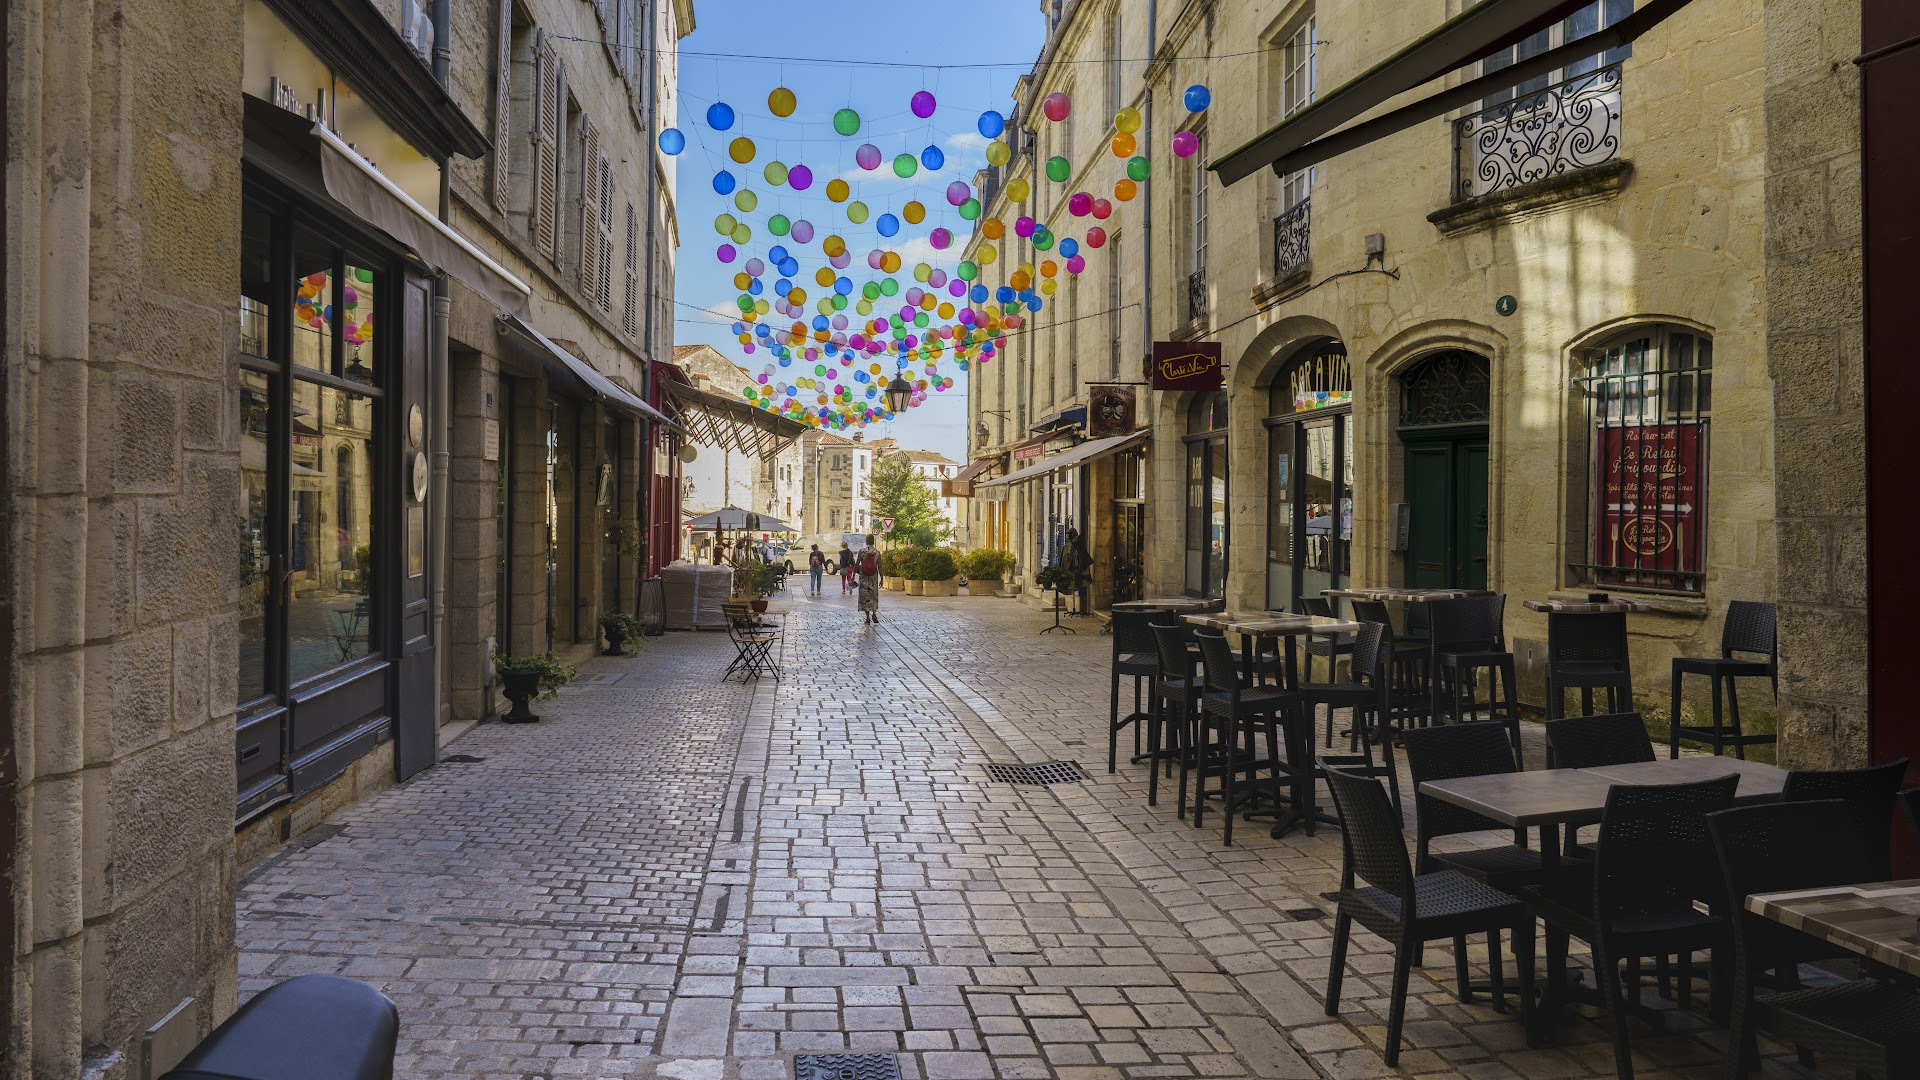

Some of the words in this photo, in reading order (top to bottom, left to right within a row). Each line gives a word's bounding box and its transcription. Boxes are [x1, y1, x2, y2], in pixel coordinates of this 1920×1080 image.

[1188, 355, 1205, 372] Vin
[1290, 360, 1312, 406] BAR
[1328, 353, 1349, 397] VIN
